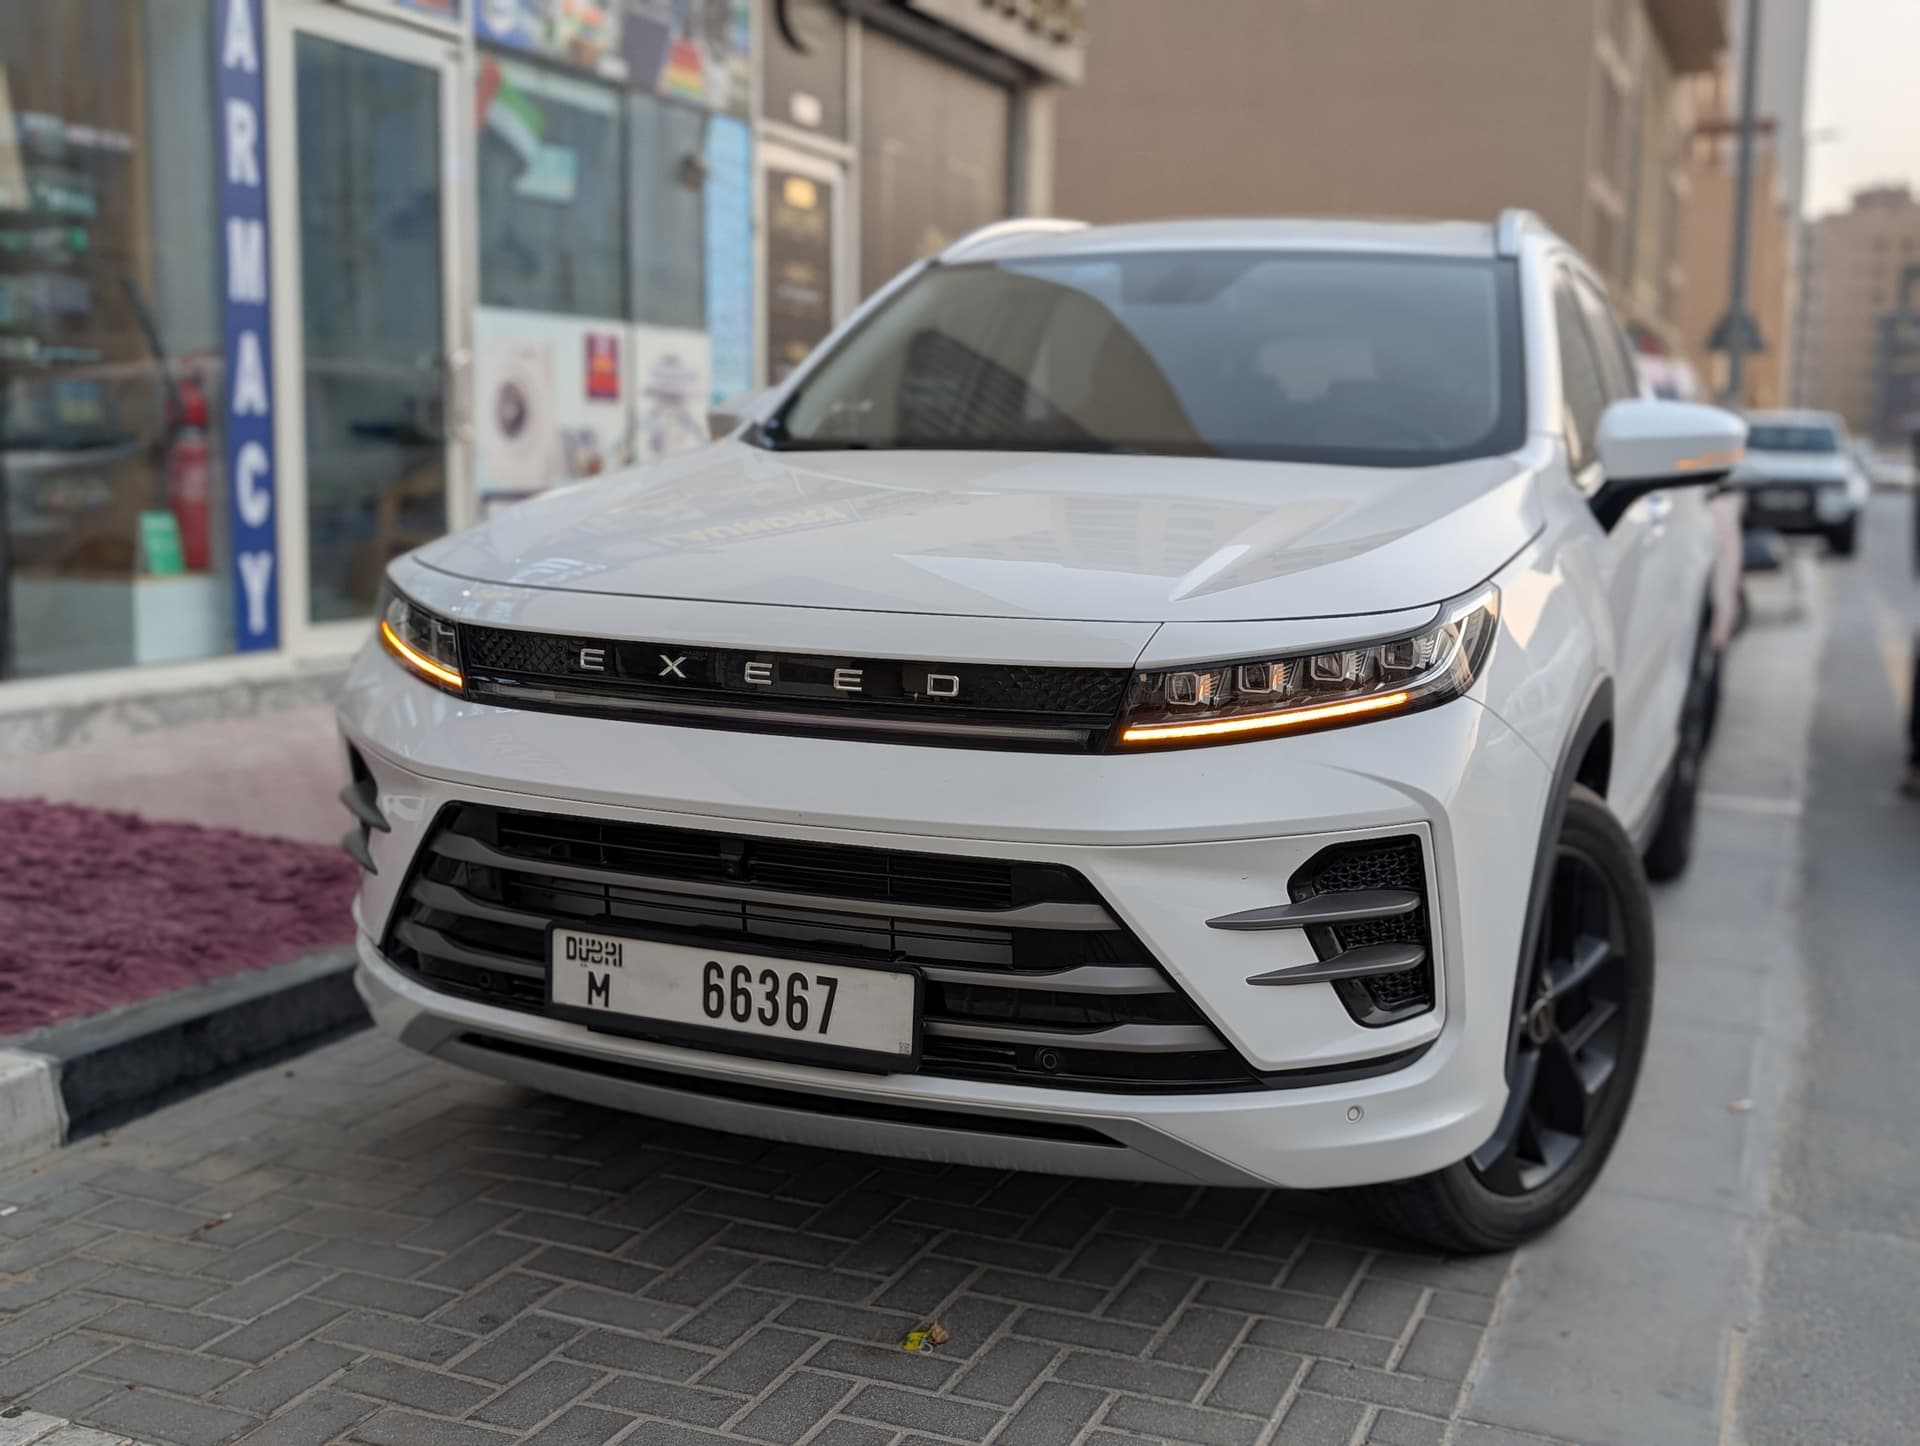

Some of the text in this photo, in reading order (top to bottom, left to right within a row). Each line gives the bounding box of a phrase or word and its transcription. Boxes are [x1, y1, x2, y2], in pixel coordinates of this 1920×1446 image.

[222, 0, 274, 635] ARMACY
[579, 647, 960, 698] EXEED
[566, 936, 622, 968] DUBAI
[587, 961, 838, 1035] M 66367
